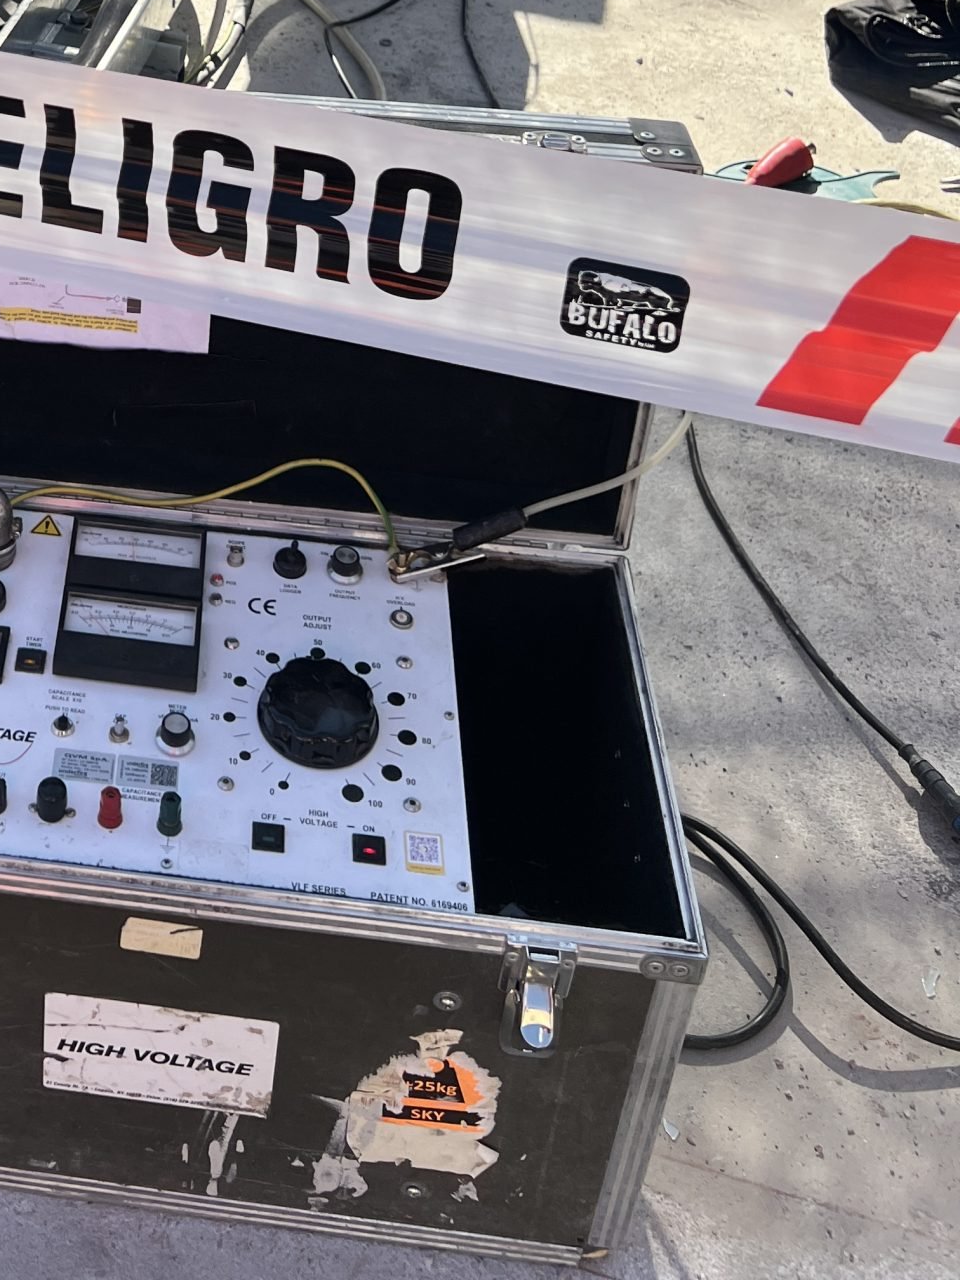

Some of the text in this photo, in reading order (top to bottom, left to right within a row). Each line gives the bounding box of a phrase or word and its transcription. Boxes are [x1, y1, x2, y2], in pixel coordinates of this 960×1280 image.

[567, 298, 677, 344] BUFALO
[585, 330, 637, 346] SAFETY
[248, 598, 277, 616] CE
[386, 599, 416, 607] OVERLOAD
[302, 614, 332, 623] OUTPUT
[303, 622, 332, 631] ADJUST
[372, 662, 382, 670] 60
[223, 672, 233, 680] 30
[48, 688, 86, 698] CAPACITANCE
[407, 692, 418, 700] 70
[406, 778, 416, 786] 90
[122, 788, 162, 798] CAPACITANCE
[269, 788, 275, 796] 0
[368, 800, 383, 808] 100
[260, 812, 278, 821] OFF
[308, 809, 329, 818] HIGH
[300, 818, 338, 828] VOLTAGE
[362, 824, 376, 832] ON
[291, 882, 346, 896] VLF SERIES
[370, 892, 468, 912] PATENT NO. 6169406
[56, 1038, 254, 1076] HIGH VOLTAGE
[410, 1108, 446, 1121] SKY
